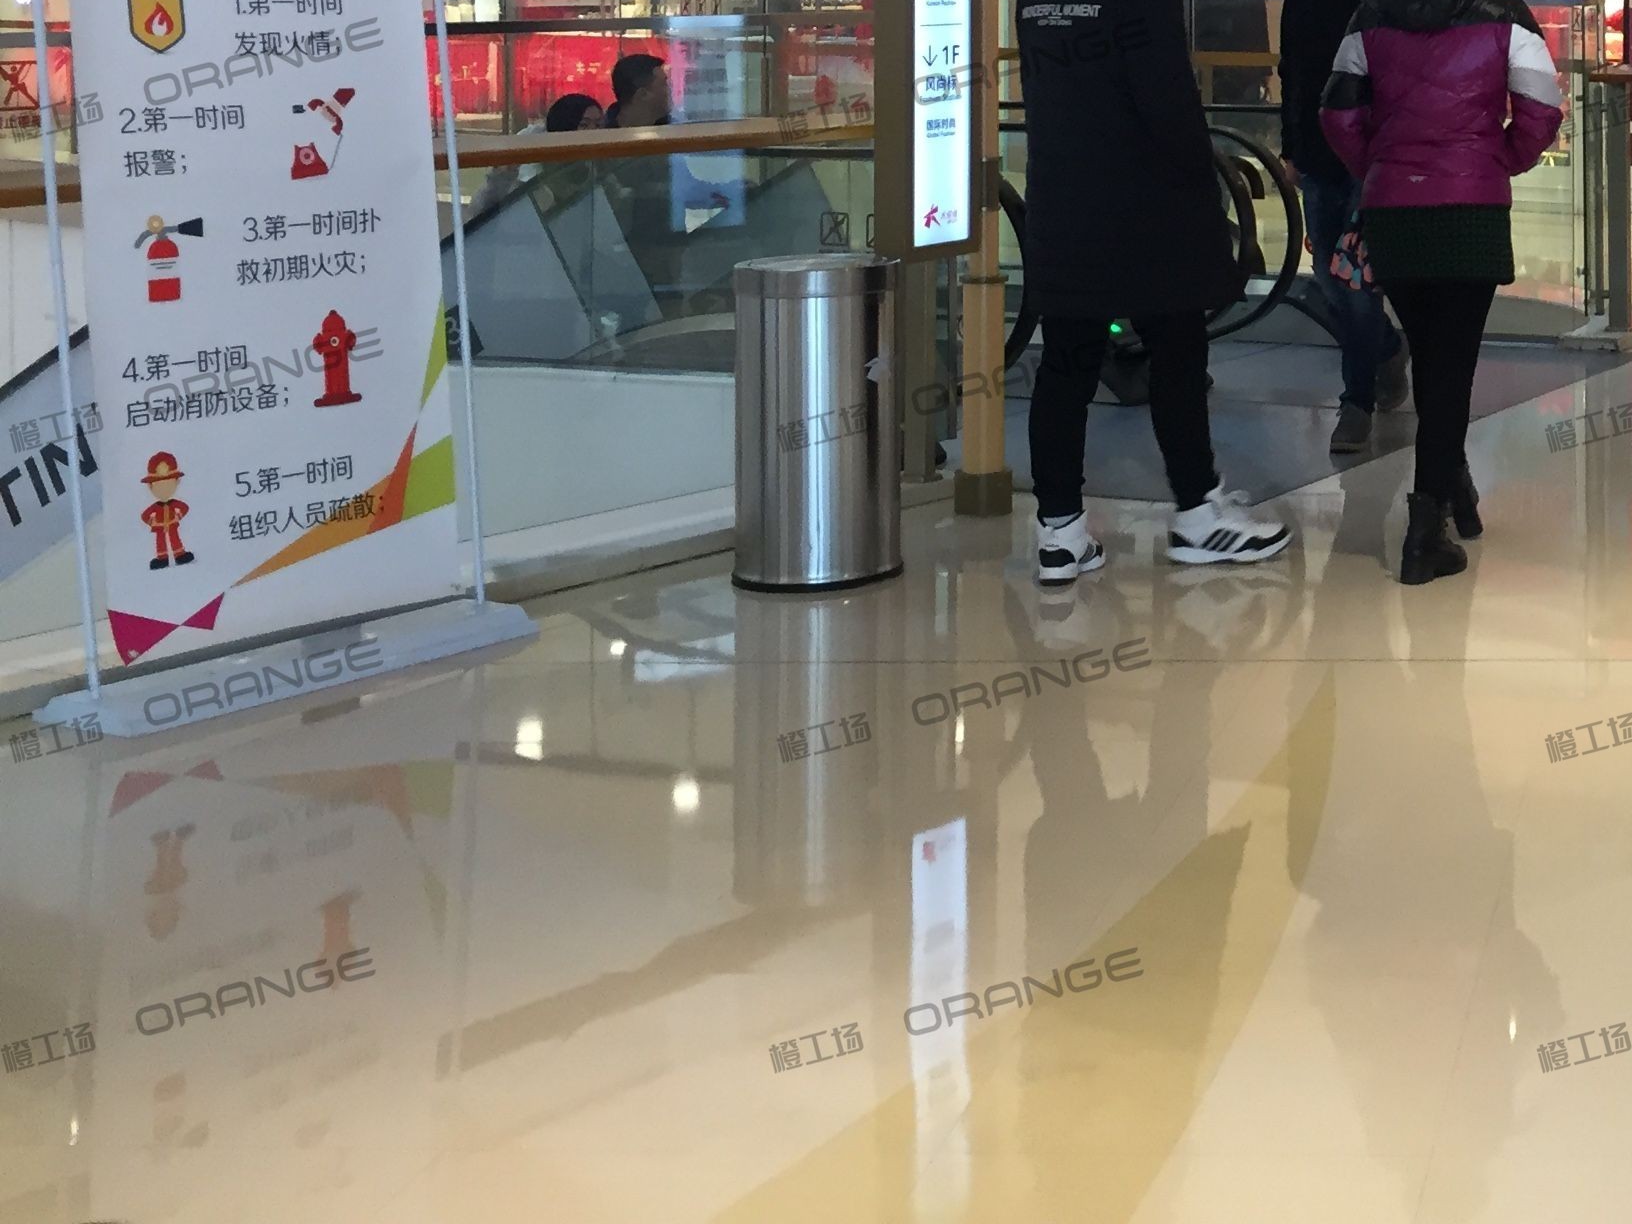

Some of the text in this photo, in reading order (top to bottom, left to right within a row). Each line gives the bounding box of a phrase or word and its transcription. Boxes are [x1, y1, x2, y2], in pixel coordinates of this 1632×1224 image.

[942, 45, 960, 65] 1F
[119, 105, 246, 134] 2.第一时间
[242, 210, 382, 243] 3.第一时间扑
[122, 345, 249, 383] 4.第一时间
[235, 456, 353, 498] 5.第一时间
